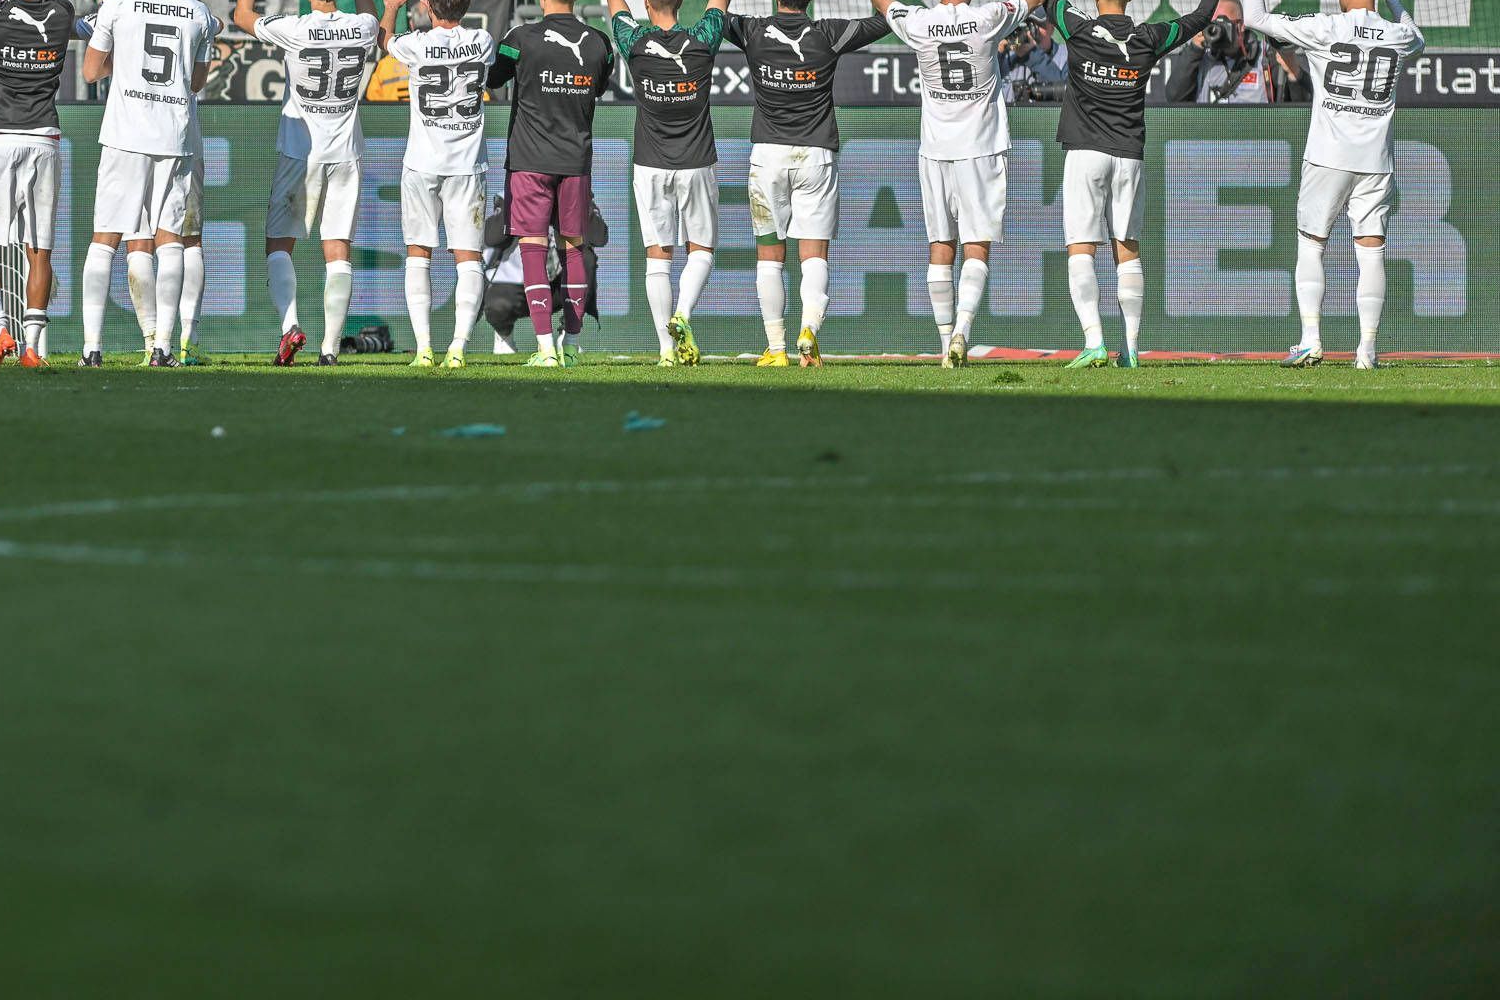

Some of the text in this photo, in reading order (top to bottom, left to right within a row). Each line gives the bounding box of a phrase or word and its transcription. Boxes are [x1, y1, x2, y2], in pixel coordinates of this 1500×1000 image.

[133, 0, 194, 20] FRIEDRICH
[308, 27, 363, 42] NEUHAUS
[928, 21, 979, 38] KRAMER
[1354, 25, 1385, 42] NETZ
[141, 23, 183, 88] 5
[425, 42, 483, 60] HOFMANN
[295, 46, 368, 102] 32
[937, 41, 979, 93] 6
[1323, 41, 1401, 105] 20
[417, 61, 488, 120] 23
[787, 81, 817, 91] yourself
[1111, 77, 1137, 88] yourself
[670, 93, 698, 104] yourself
